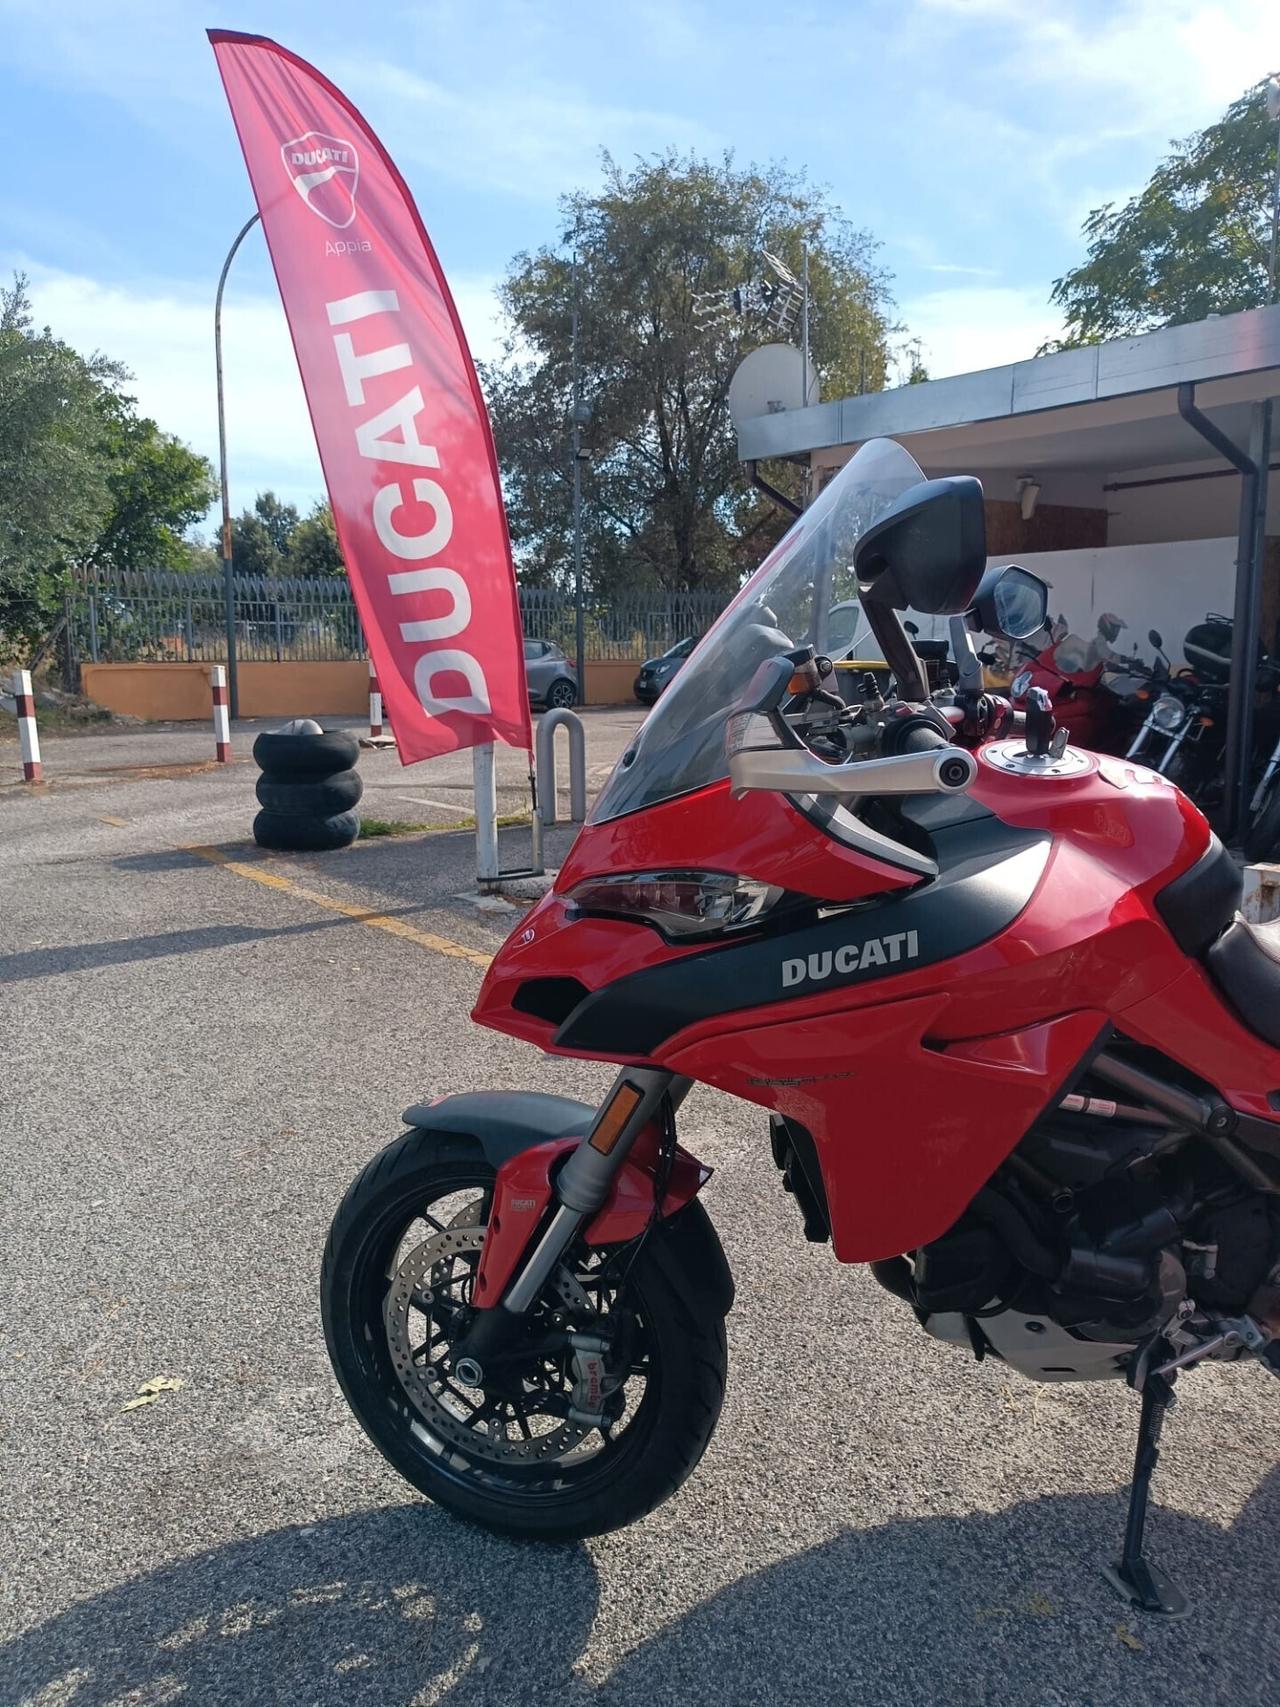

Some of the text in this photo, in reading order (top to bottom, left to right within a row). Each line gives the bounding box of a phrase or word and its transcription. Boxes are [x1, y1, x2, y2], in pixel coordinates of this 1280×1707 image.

[291, 147, 349, 166] DUCATI
[325, 239, 372, 256] Appia
[326, 289, 492, 718] DUCATI
[781, 929, 919, 988] DUCATI
